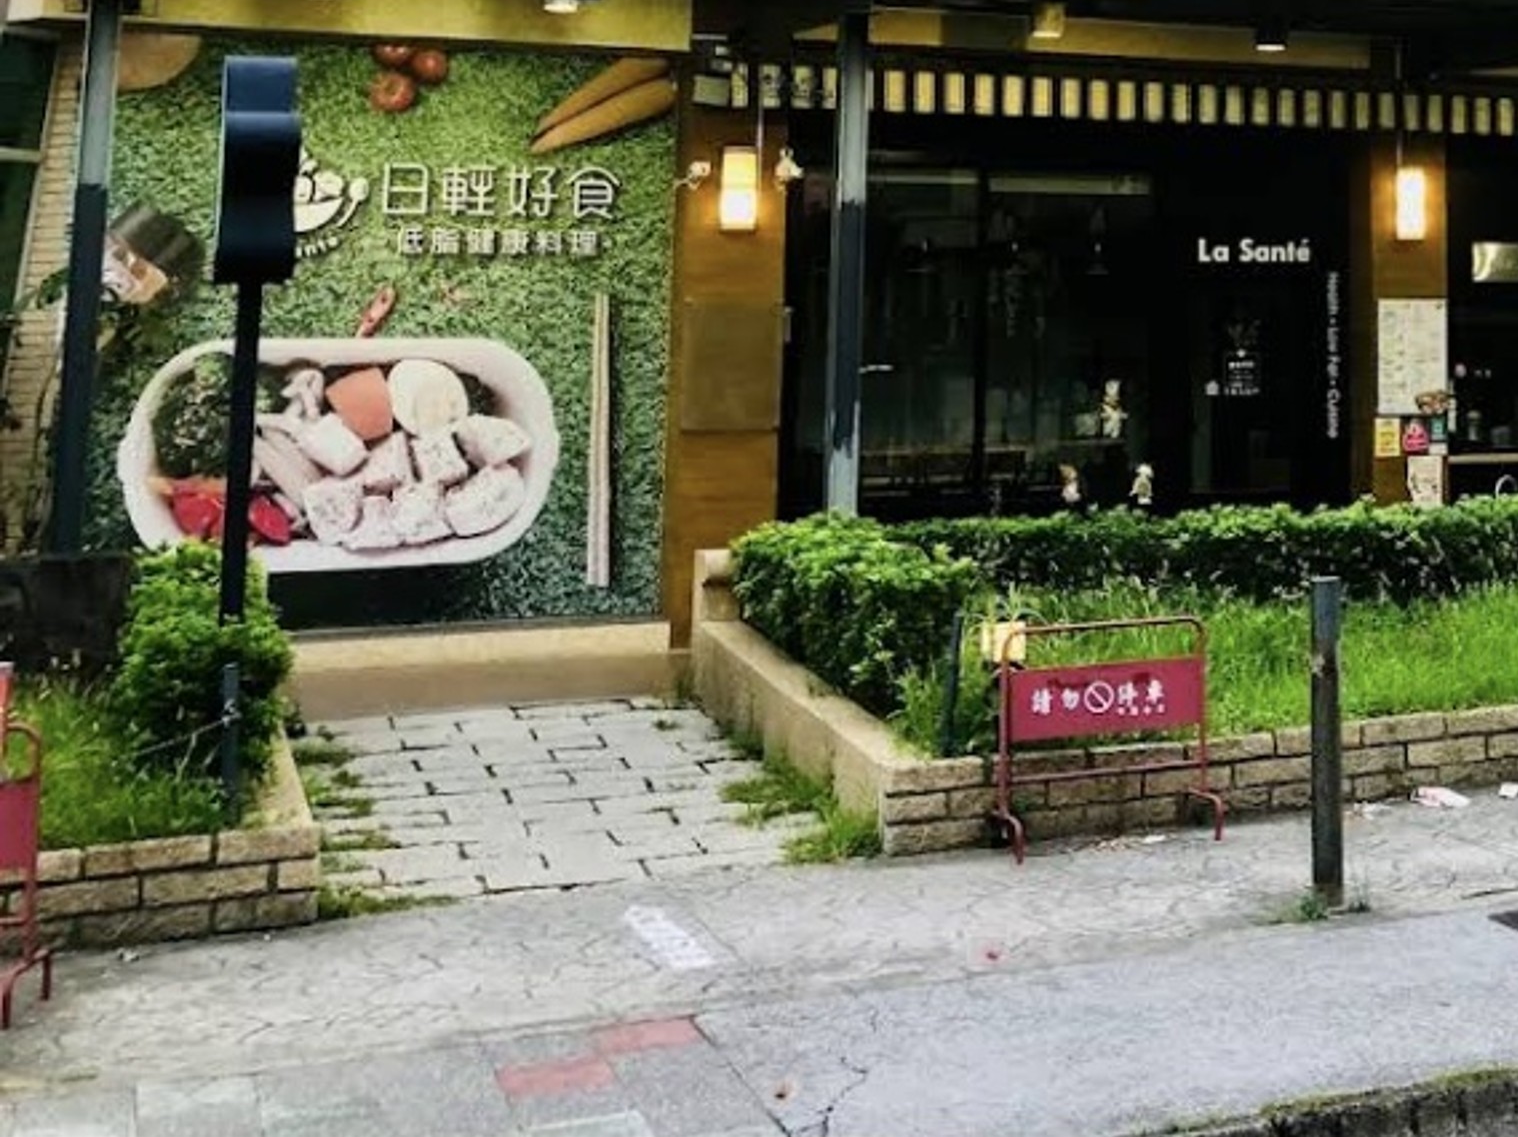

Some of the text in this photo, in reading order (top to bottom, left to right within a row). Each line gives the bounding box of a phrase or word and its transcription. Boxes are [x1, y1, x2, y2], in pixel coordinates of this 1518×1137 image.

[382, 163, 622, 220] 日輕好食
[397, 225, 599, 256] 低脂健康料理
[1198, 236, 1311, 263] La Santé
